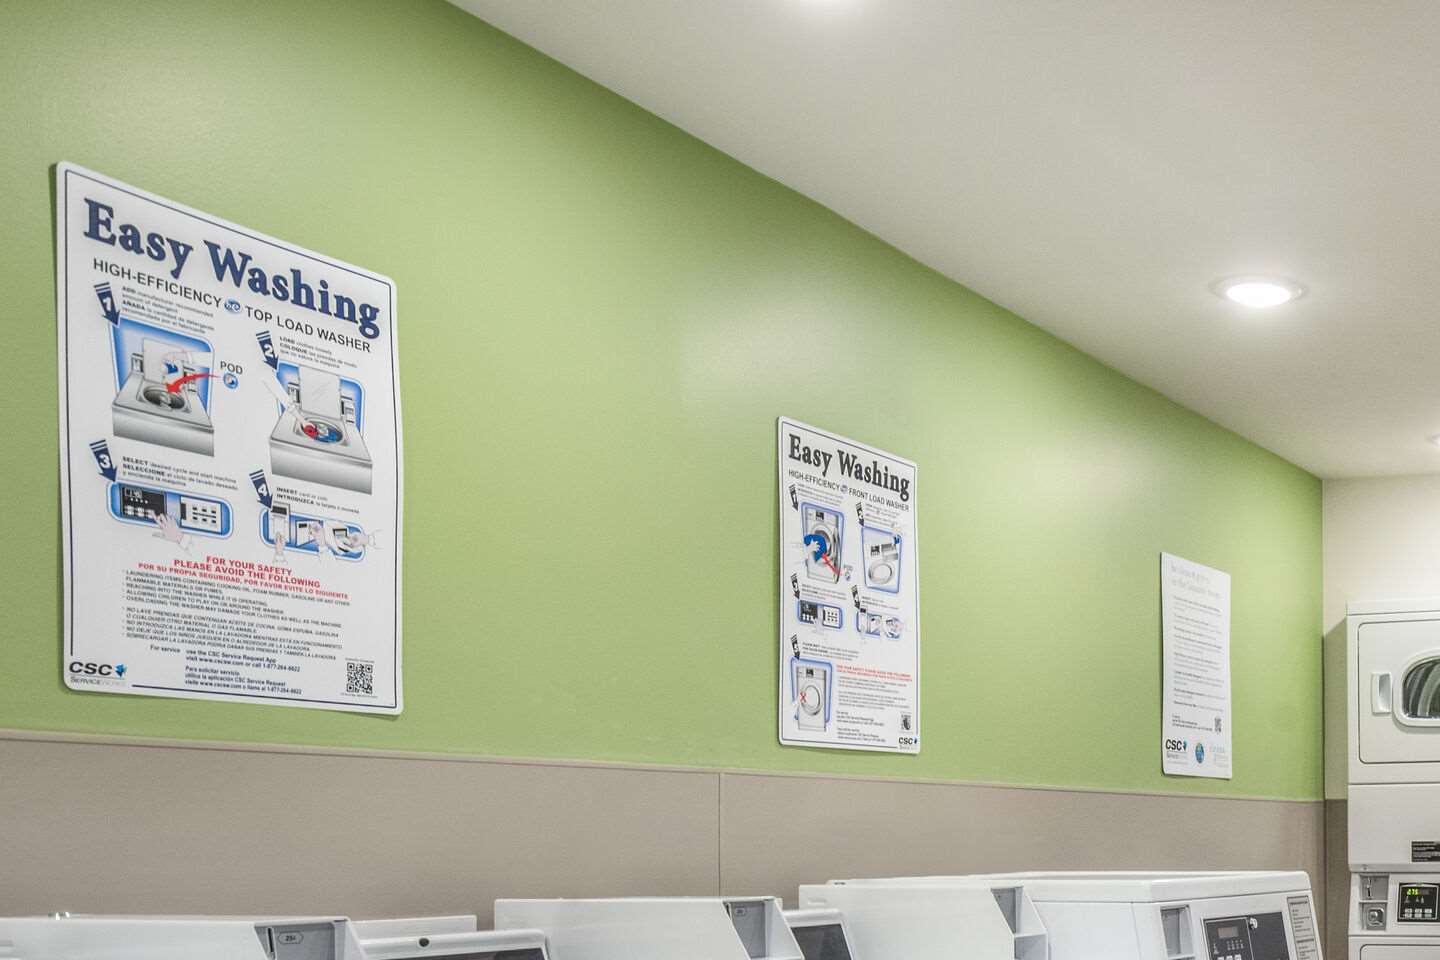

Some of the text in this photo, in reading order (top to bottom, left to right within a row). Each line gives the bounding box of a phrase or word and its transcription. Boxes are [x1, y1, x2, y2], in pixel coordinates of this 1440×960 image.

[84, 198, 380, 339] Easy Washing
[93, 258, 222, 308] HIGH-EFFICIENCY
[245, 306, 273, 322] TOP
[277, 315, 314, 336] LOAD
[317, 327, 371, 353] WASHER
[220, 360, 243, 374] POD
[789, 434, 832, 477] Easy
[837, 449, 910, 501] Washing
[789, 469, 840, 491] HIGH-EFFICIENCY
[849, 488, 868, 500] FRONT
[869, 492, 885, 505] LOAD
[885, 498, 909, 511] WASHER
[174, 559, 320, 588] PLEASE AVOID THE FOLLOWING
[206, 556, 291, 575] FOR YOUR SAFETY
[69, 661, 112, 676] CSC
[899, 737, 913, 745] CSC
[1165, 738, 1182, 751] CSC
